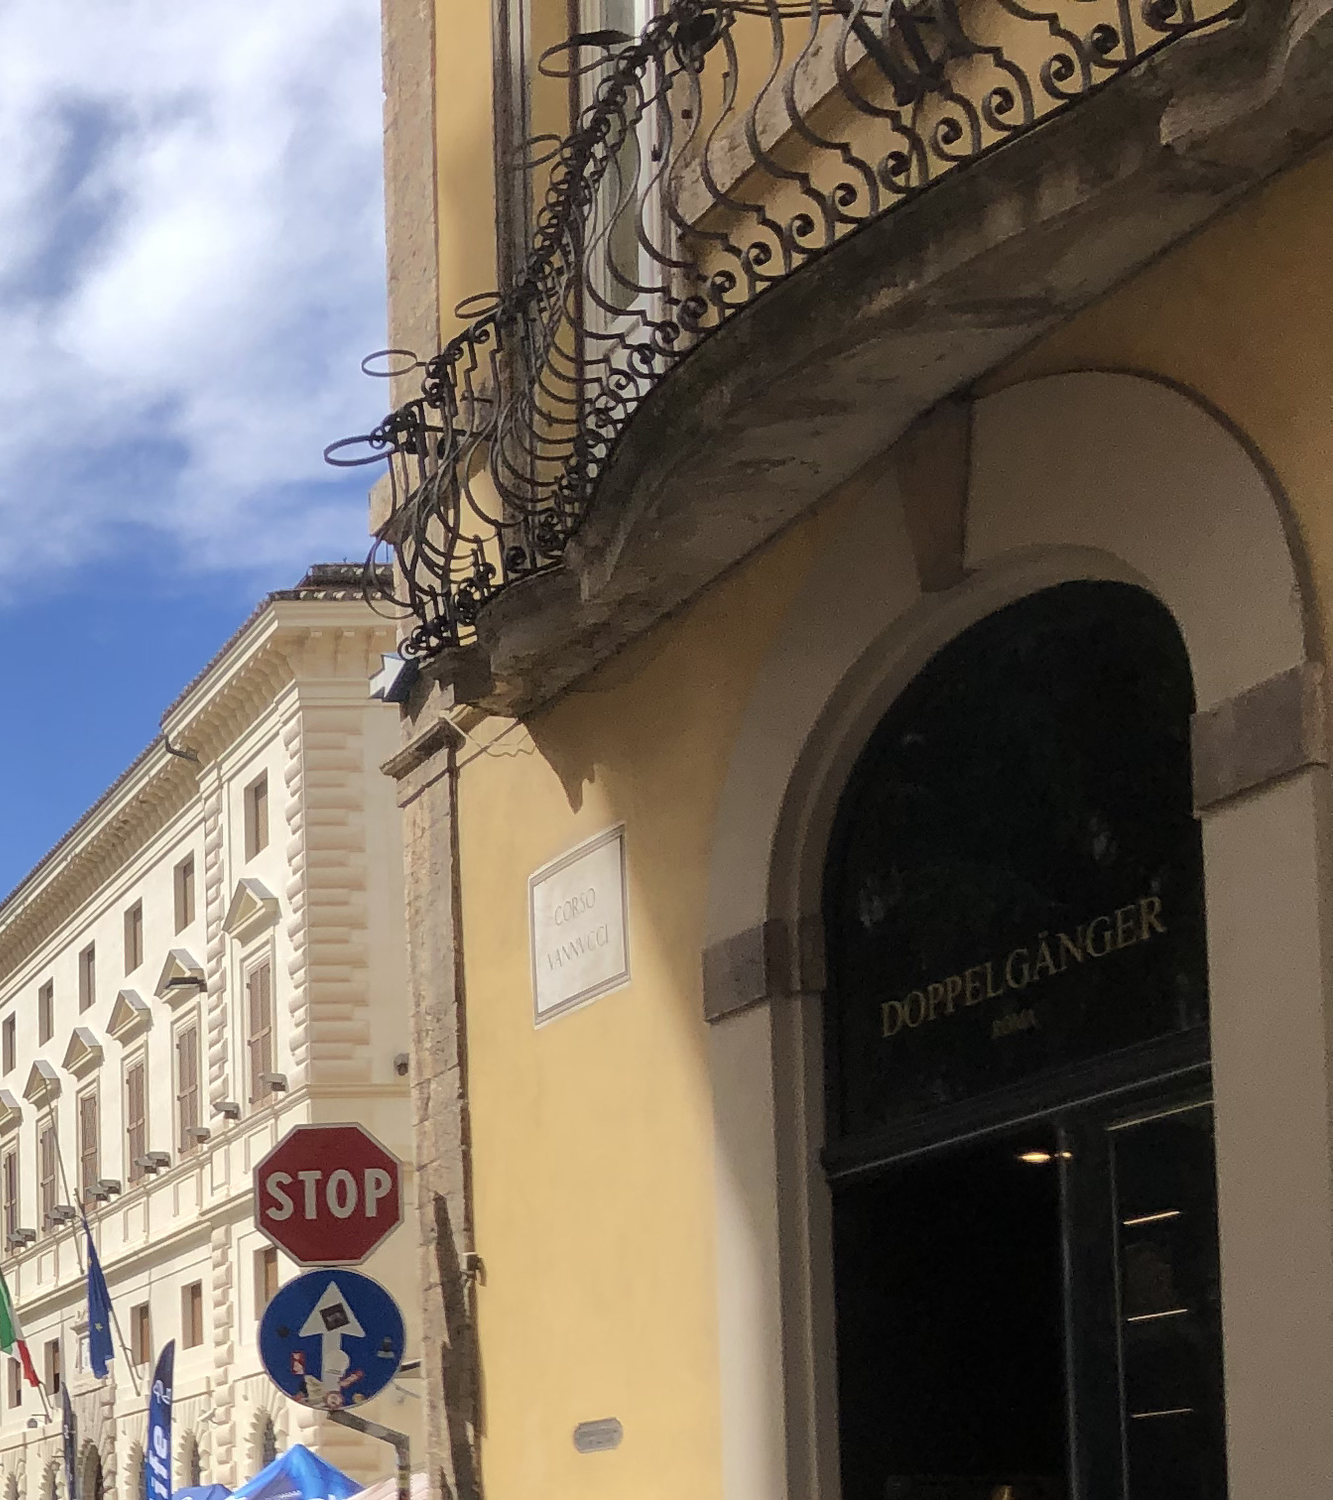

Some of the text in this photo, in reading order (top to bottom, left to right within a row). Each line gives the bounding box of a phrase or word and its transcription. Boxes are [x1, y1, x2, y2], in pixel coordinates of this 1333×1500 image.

[554, 887, 597, 927] CORSO
[881, 895, 1168, 1038] DOPPELGÄNGER
[265, 1168, 393, 1221] STOP
